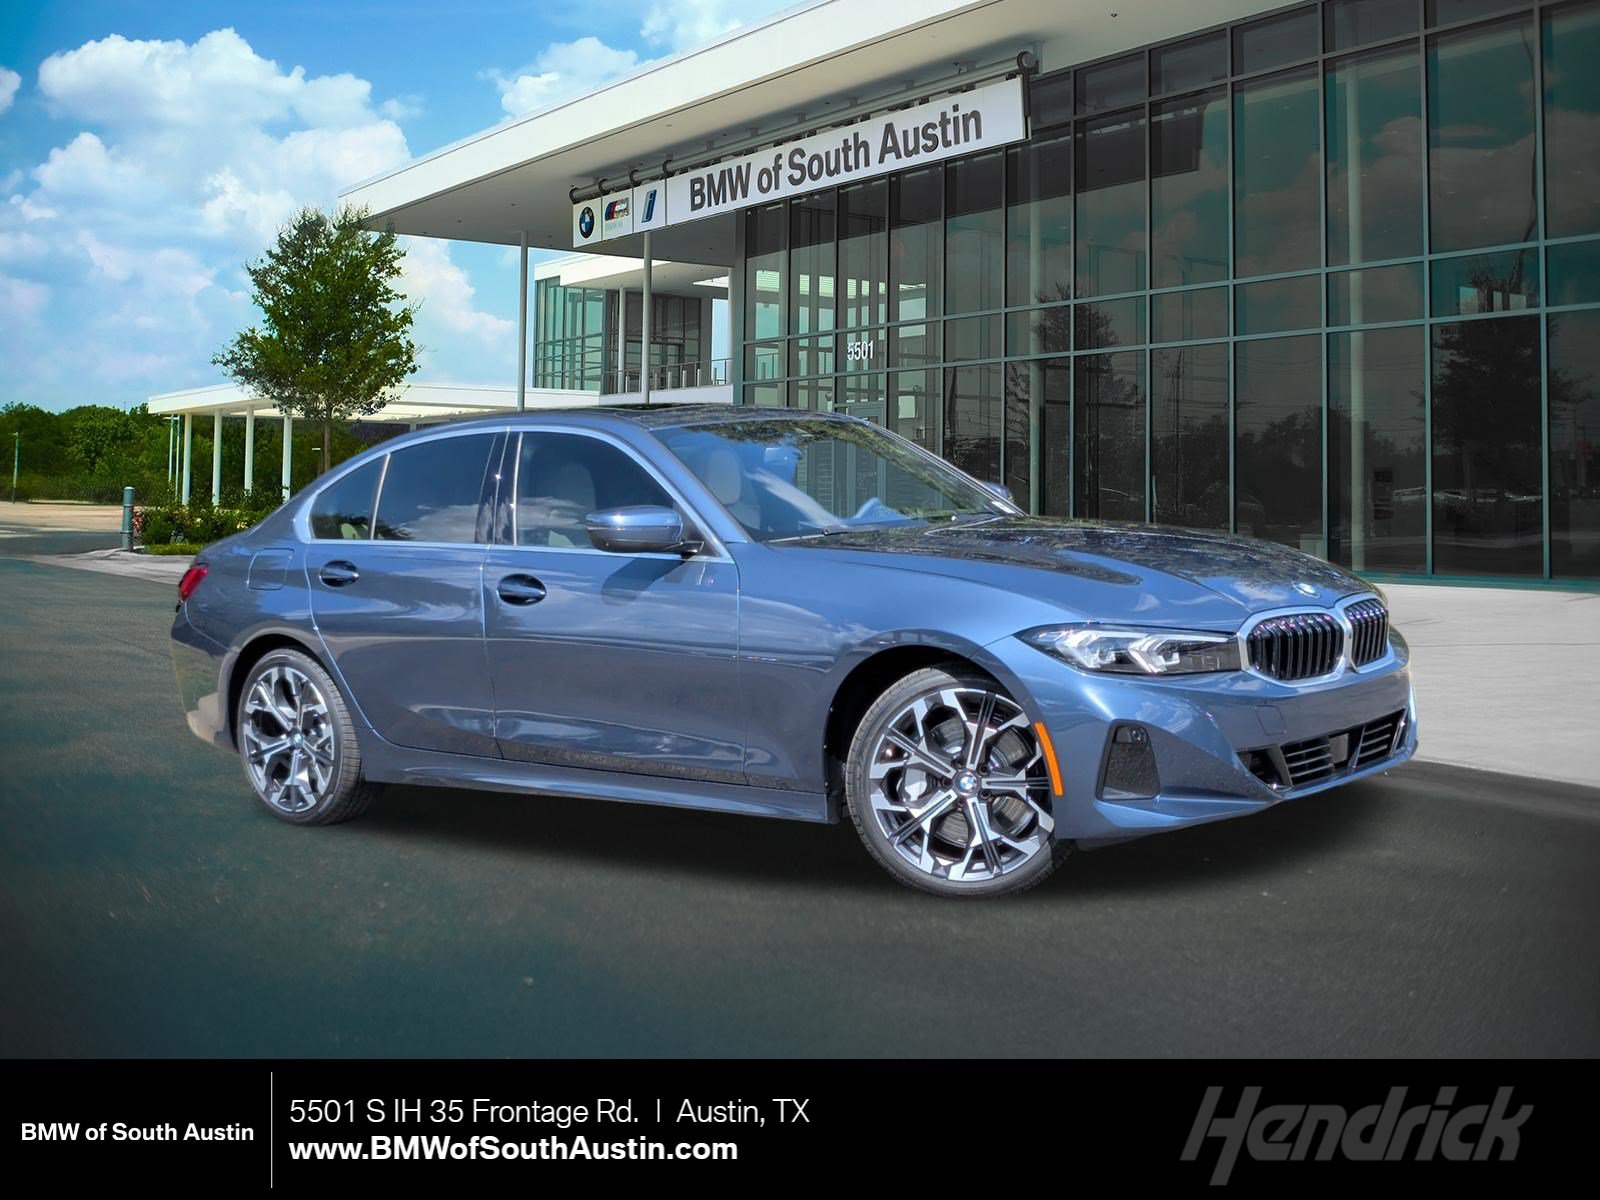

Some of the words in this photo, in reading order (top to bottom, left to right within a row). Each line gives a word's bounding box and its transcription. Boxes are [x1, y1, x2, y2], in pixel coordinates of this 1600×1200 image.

[690, 162, 752, 212] BMW
[757, 153, 783, 194] of
[787, 131, 870, 186] South
[878, 103, 982, 164] Austin
[847, 339, 874, 361] 5501
